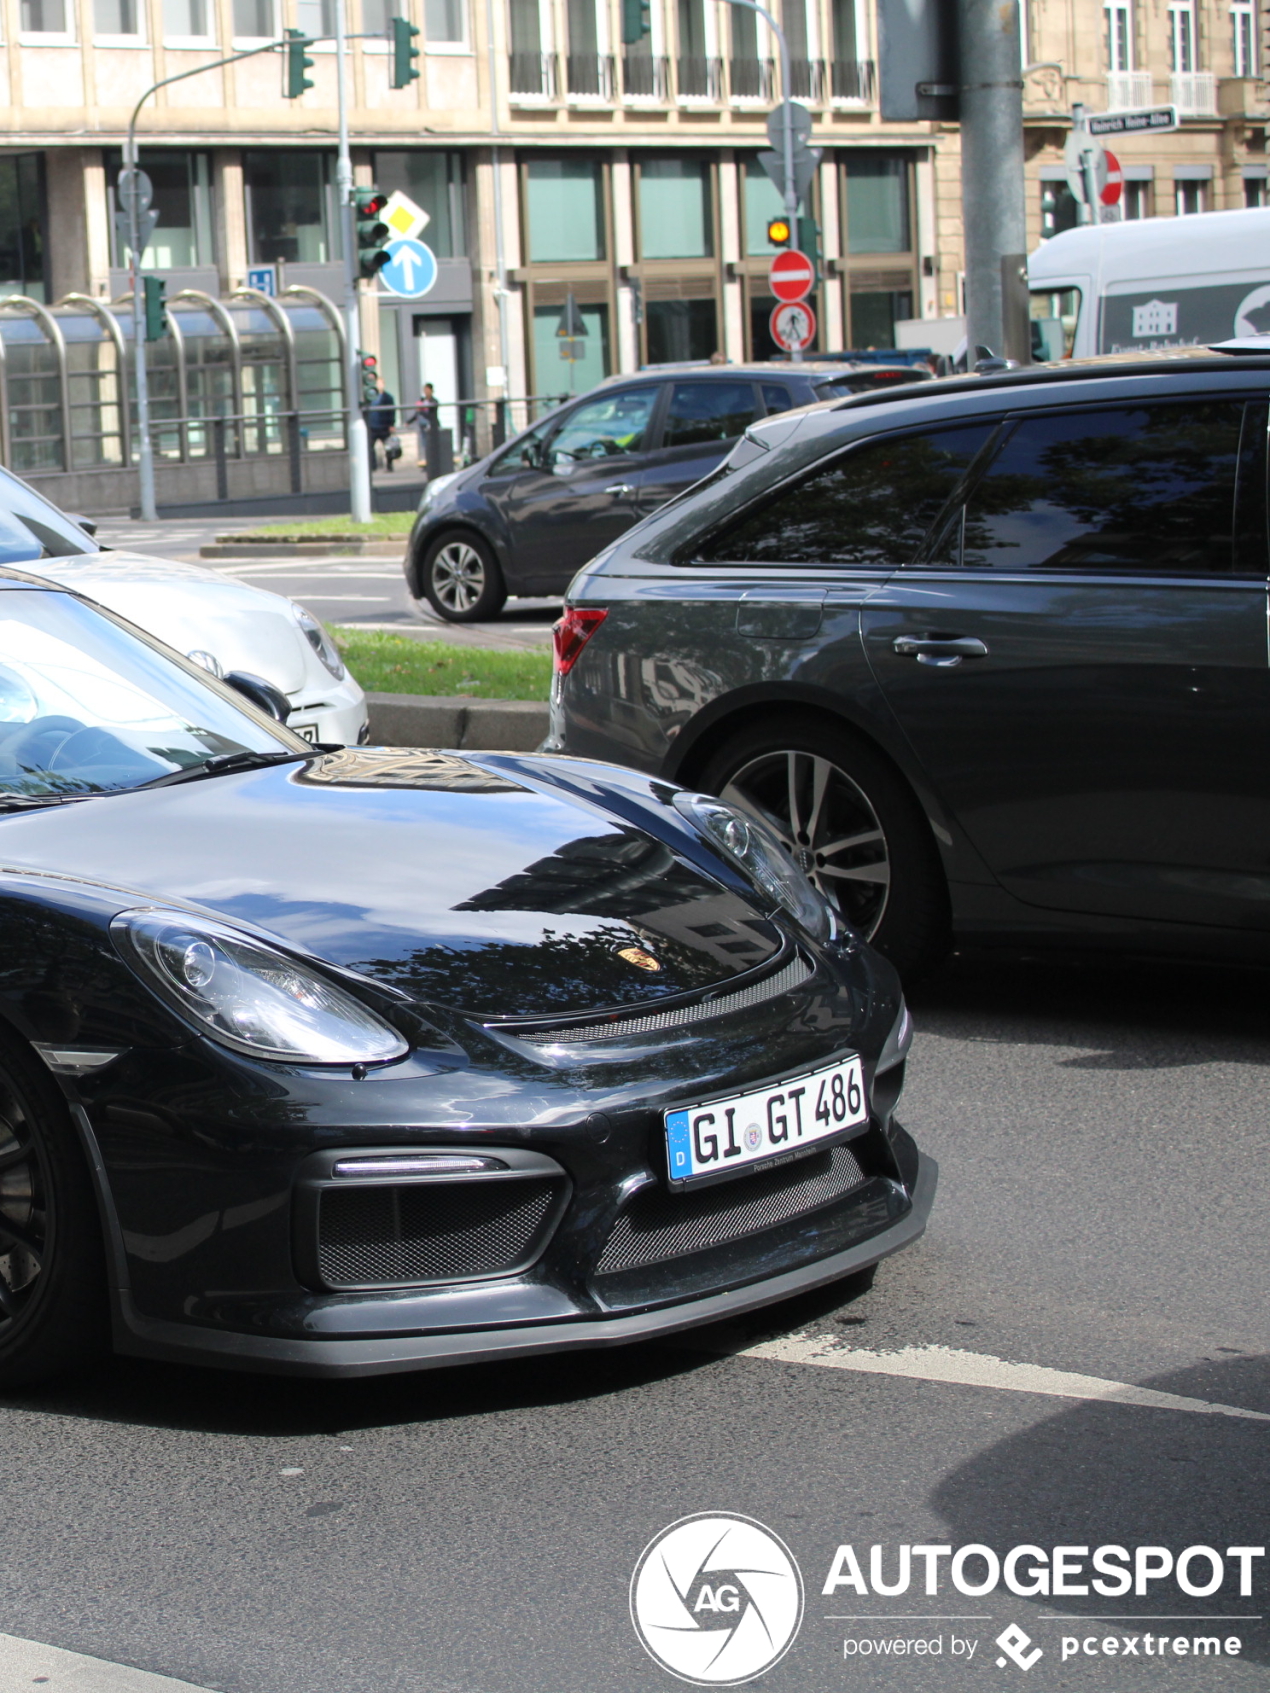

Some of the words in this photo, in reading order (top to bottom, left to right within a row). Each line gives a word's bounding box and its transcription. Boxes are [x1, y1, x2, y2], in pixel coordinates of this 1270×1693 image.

[675, 1151, 686, 1167] D
[693, 1107, 742, 1165] GI
[766, 1086, 806, 1145] GT
[815, 1067, 861, 1127] 486
[753, 1160, 773, 1172] Porsche
[774, 1154, 794, 1166] Zentrum
